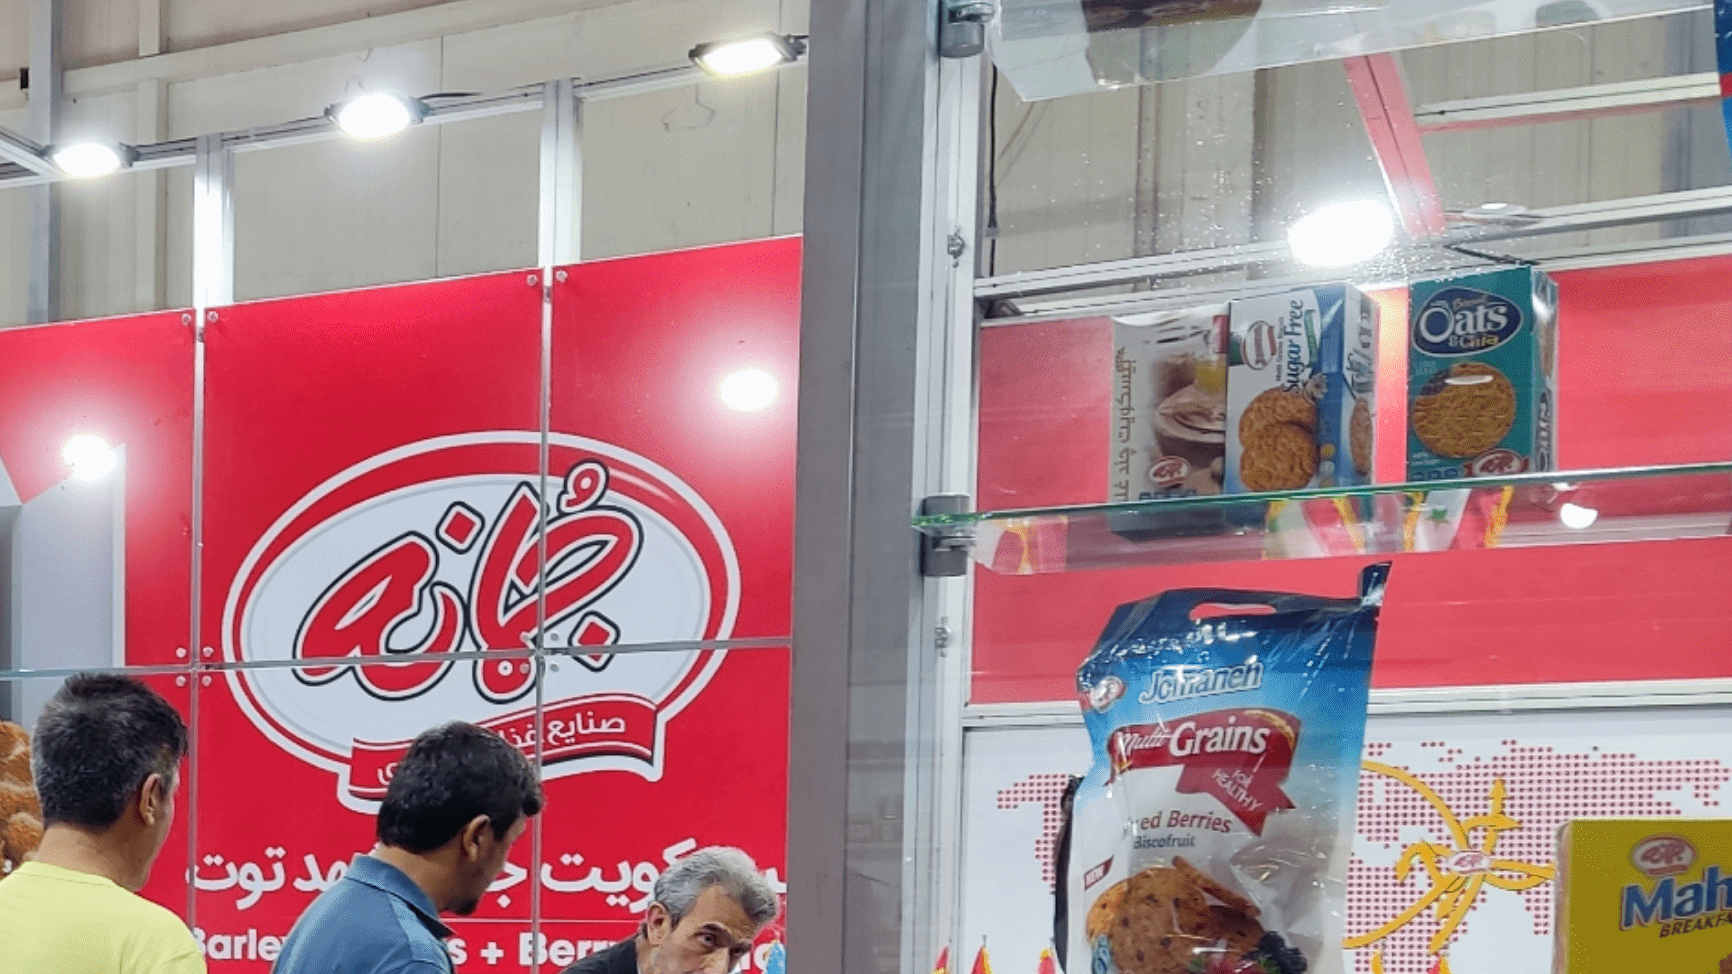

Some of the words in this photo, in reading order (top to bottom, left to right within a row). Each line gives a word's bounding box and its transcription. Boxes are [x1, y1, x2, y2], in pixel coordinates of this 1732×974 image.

[1282, 299, 1304, 336] Free
[1419, 300, 1509, 343] Oats
[1281, 339, 1305, 394] Sugar
[548, 710, 626, 745] صنایع
[1169, 714, 1271, 757] Grains
[1167, 810, 1233, 834] Berries
[185, 846, 287, 910] توت
